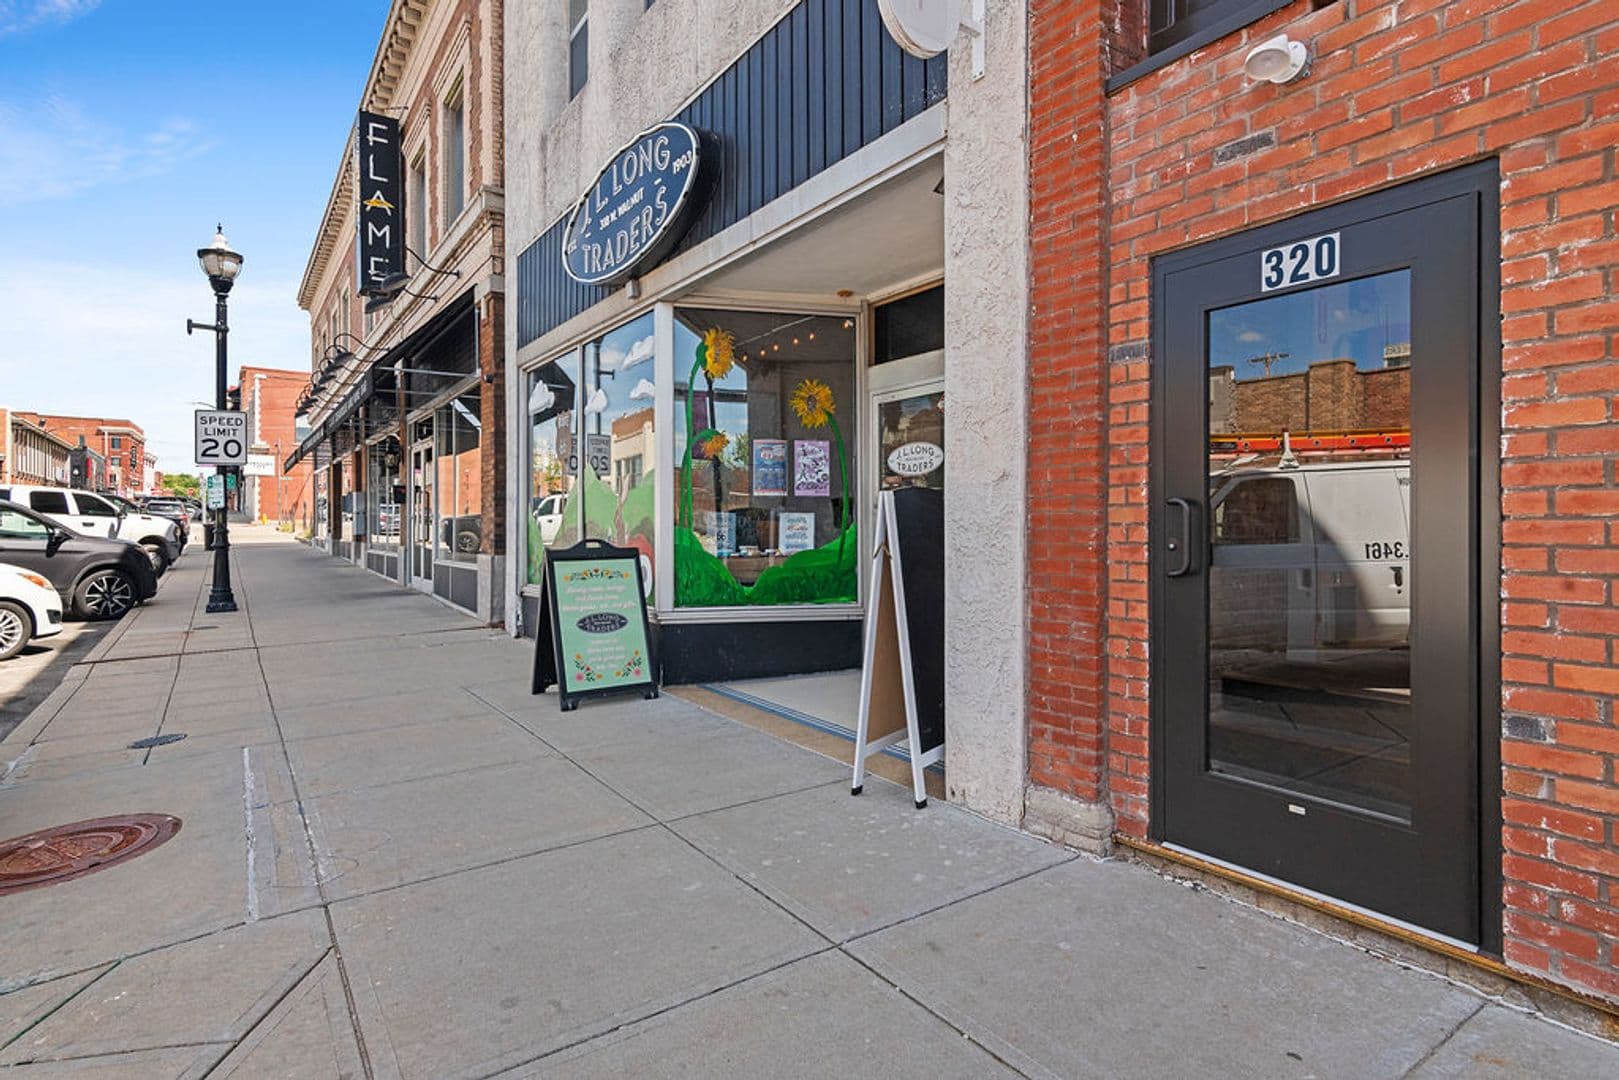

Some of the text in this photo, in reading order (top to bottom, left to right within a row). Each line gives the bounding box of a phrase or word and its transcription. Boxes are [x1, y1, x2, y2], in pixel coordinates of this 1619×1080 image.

[612, 135, 670, 196] LONG
[364, 121, 394, 282] FLAME
[582, 185, 667, 274] TRADERS
[1265, 236, 1336, 288] 320
[200, 415, 243, 427] SPEED
[204, 428, 239, 437] LIMIT
[201, 438, 242, 458] 20
[910, 445, 935, 456] LONG
[896, 458, 934, 472] TRADERS
